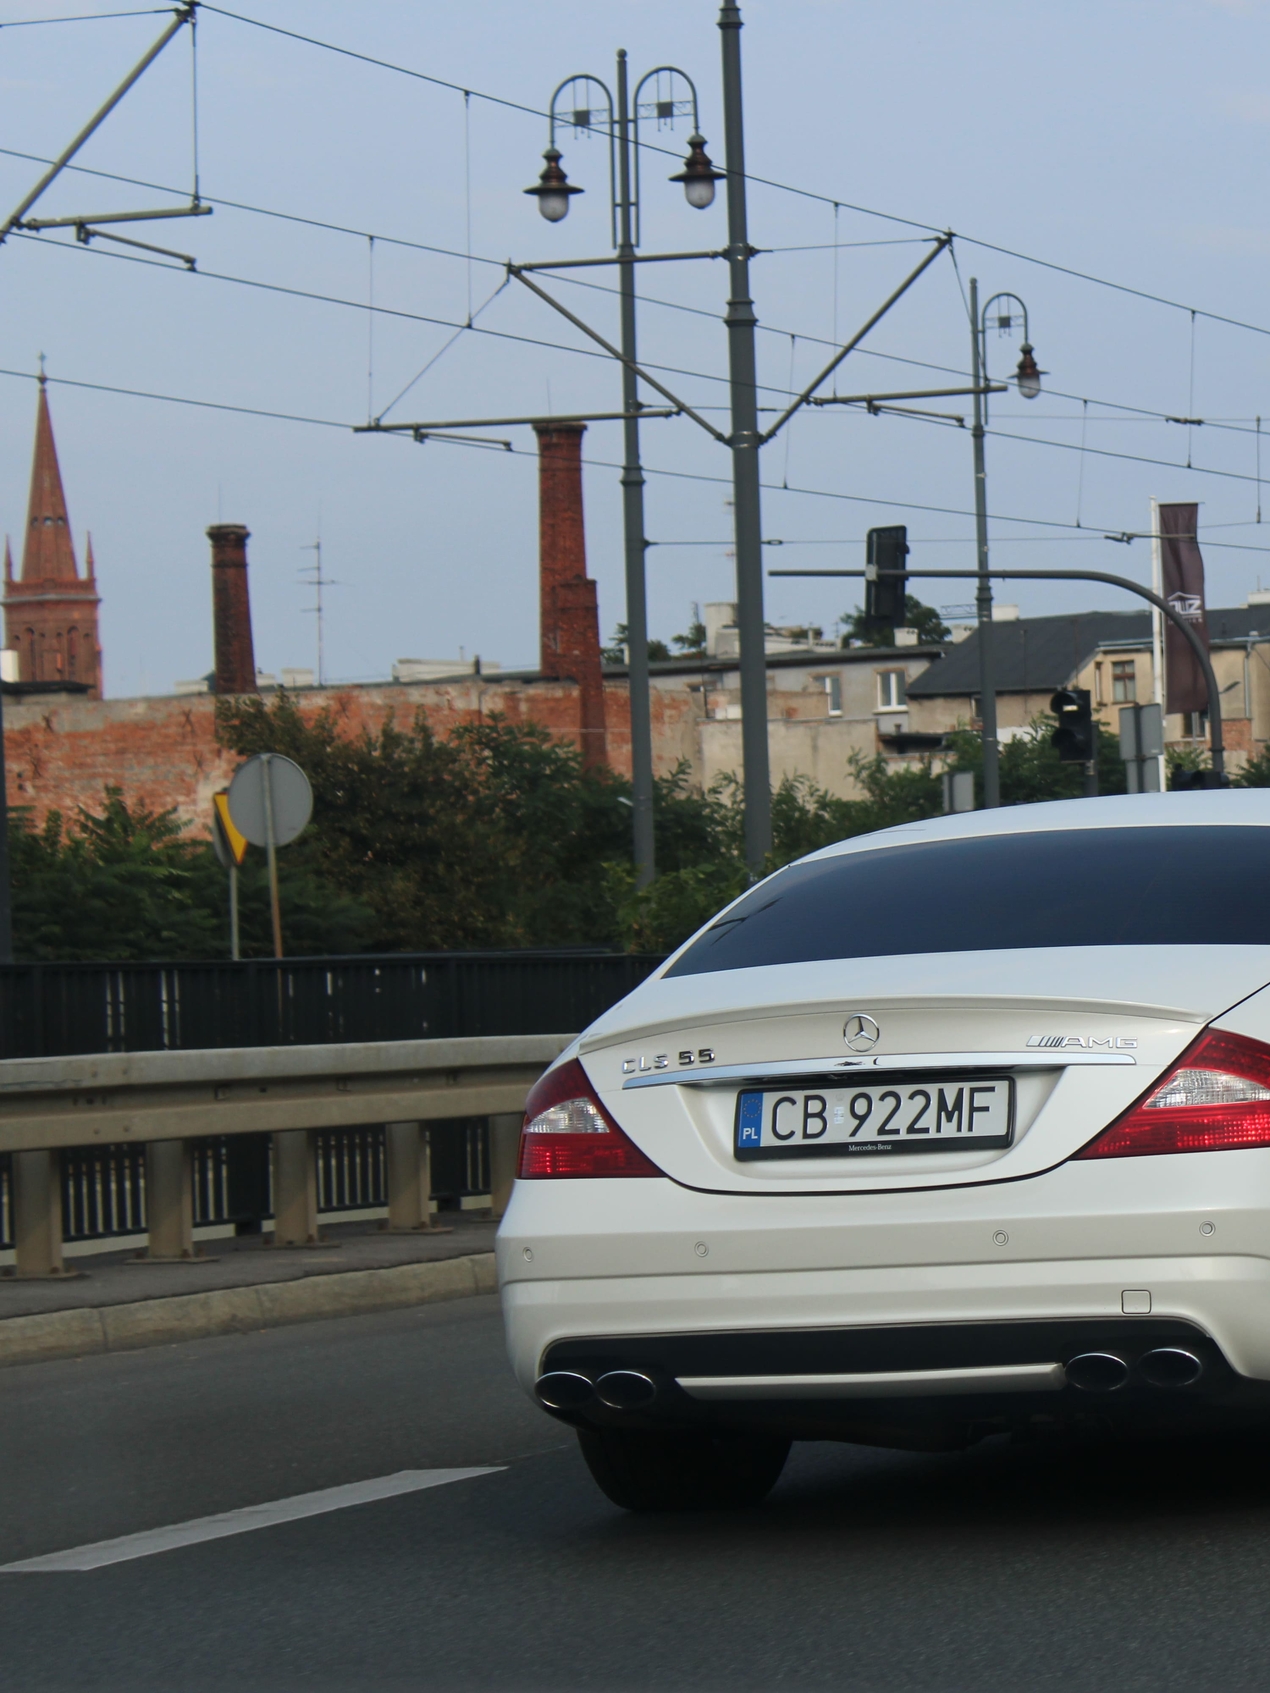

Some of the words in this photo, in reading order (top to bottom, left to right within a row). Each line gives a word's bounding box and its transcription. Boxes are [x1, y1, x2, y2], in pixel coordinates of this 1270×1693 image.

[1061, 1036, 1137, 1048] AMG
[622, 1054, 669, 1074] CLS
[678, 1048, 715, 1066] 55
[771, 1094, 829, 1141] CB
[848, 1086, 997, 1138] 922MF
[742, 1127, 758, 1140] PL
[848, 1143, 892, 1152] Mercedes-Benz
